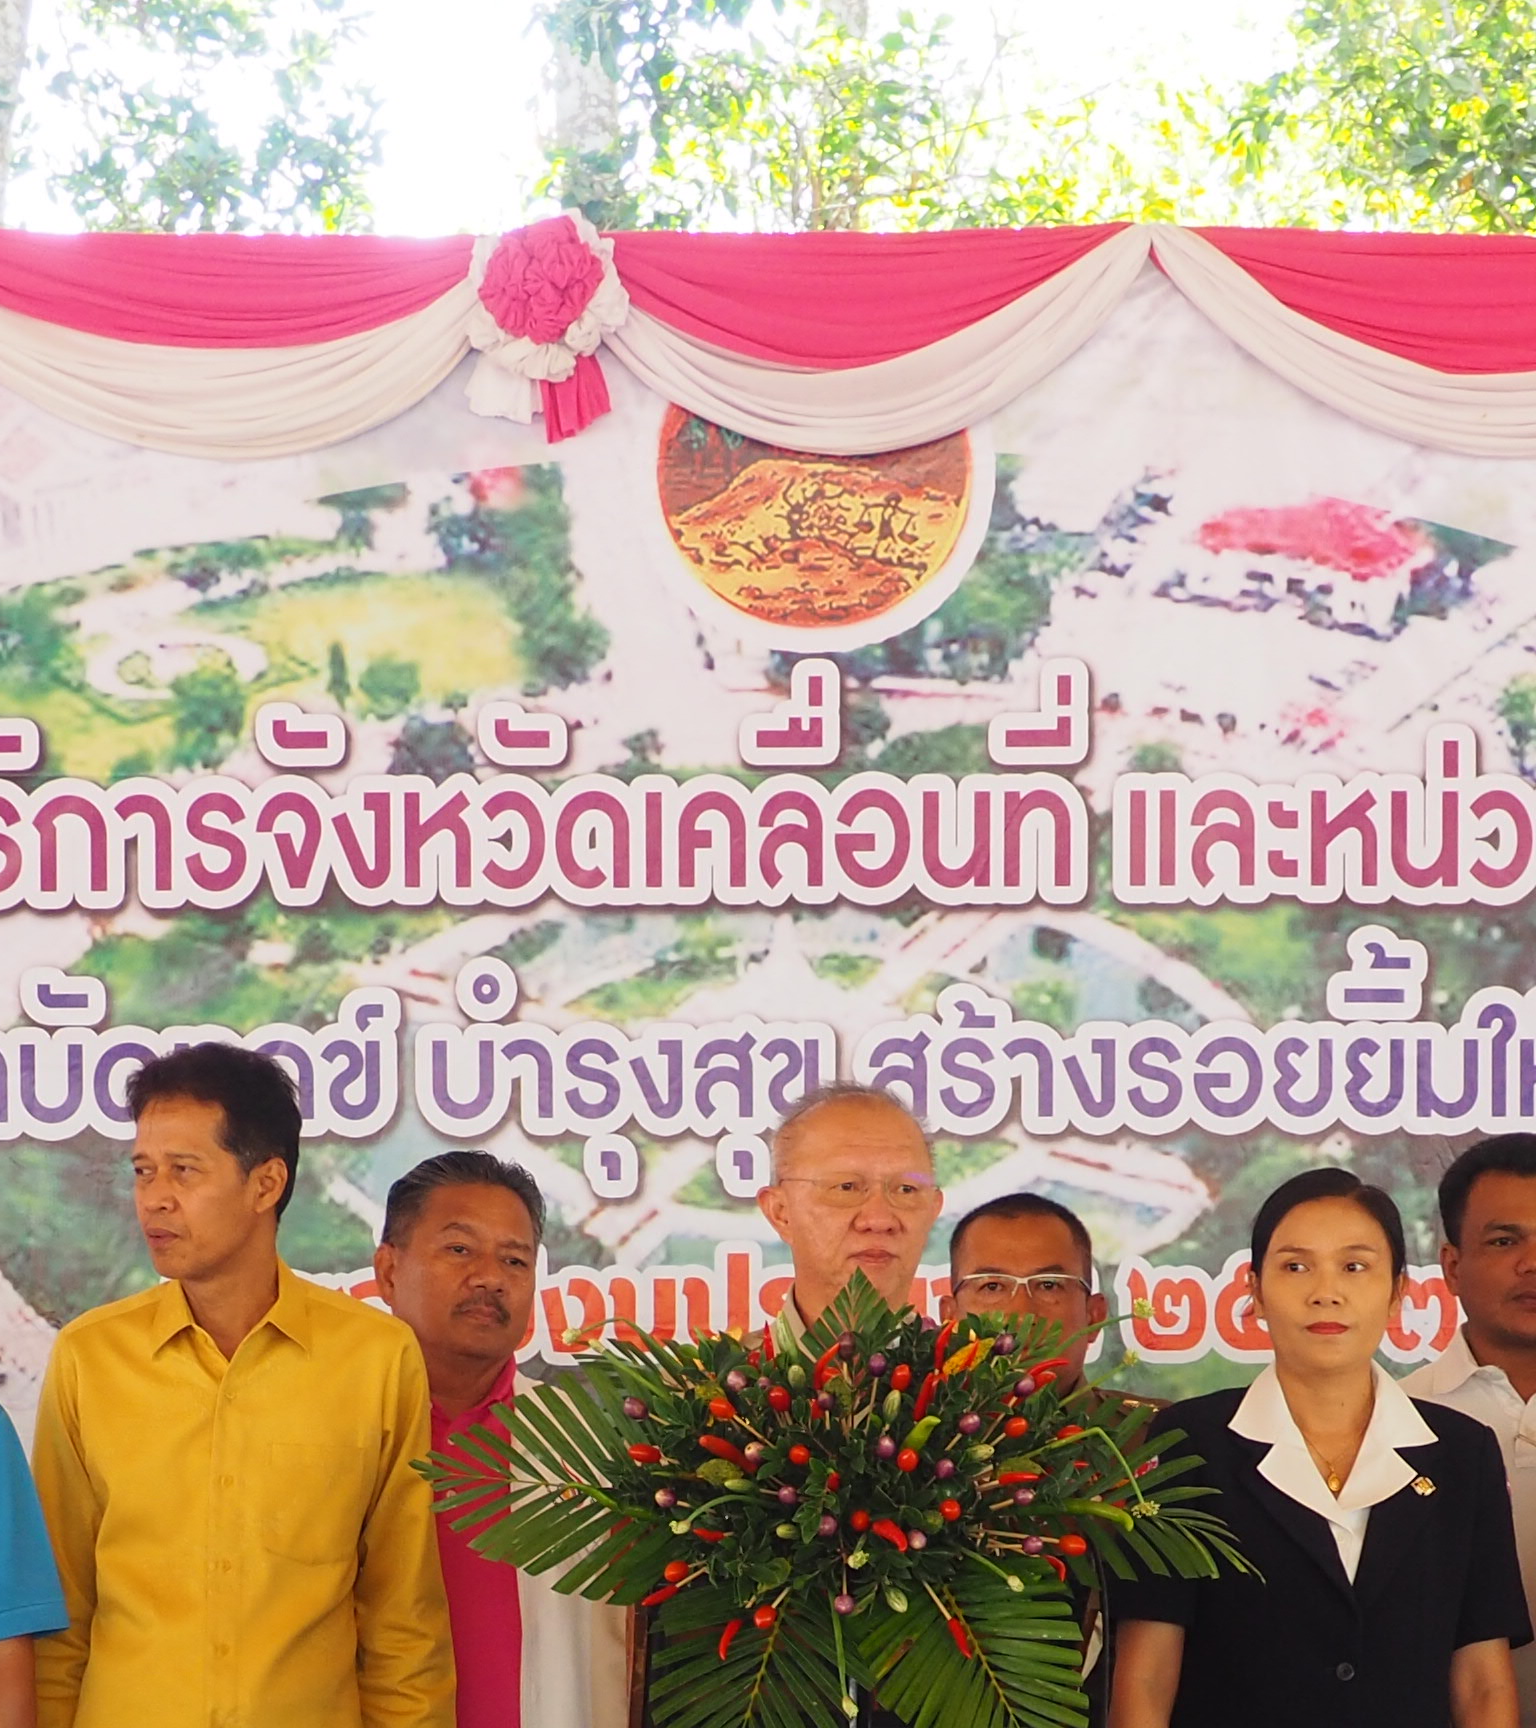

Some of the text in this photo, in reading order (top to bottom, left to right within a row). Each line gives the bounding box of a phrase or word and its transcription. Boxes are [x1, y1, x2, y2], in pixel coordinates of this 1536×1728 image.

[431, 974, 821, 1182] บำรุงสุข
[1126, 1260, 1460, 1353] ๒๕๓
